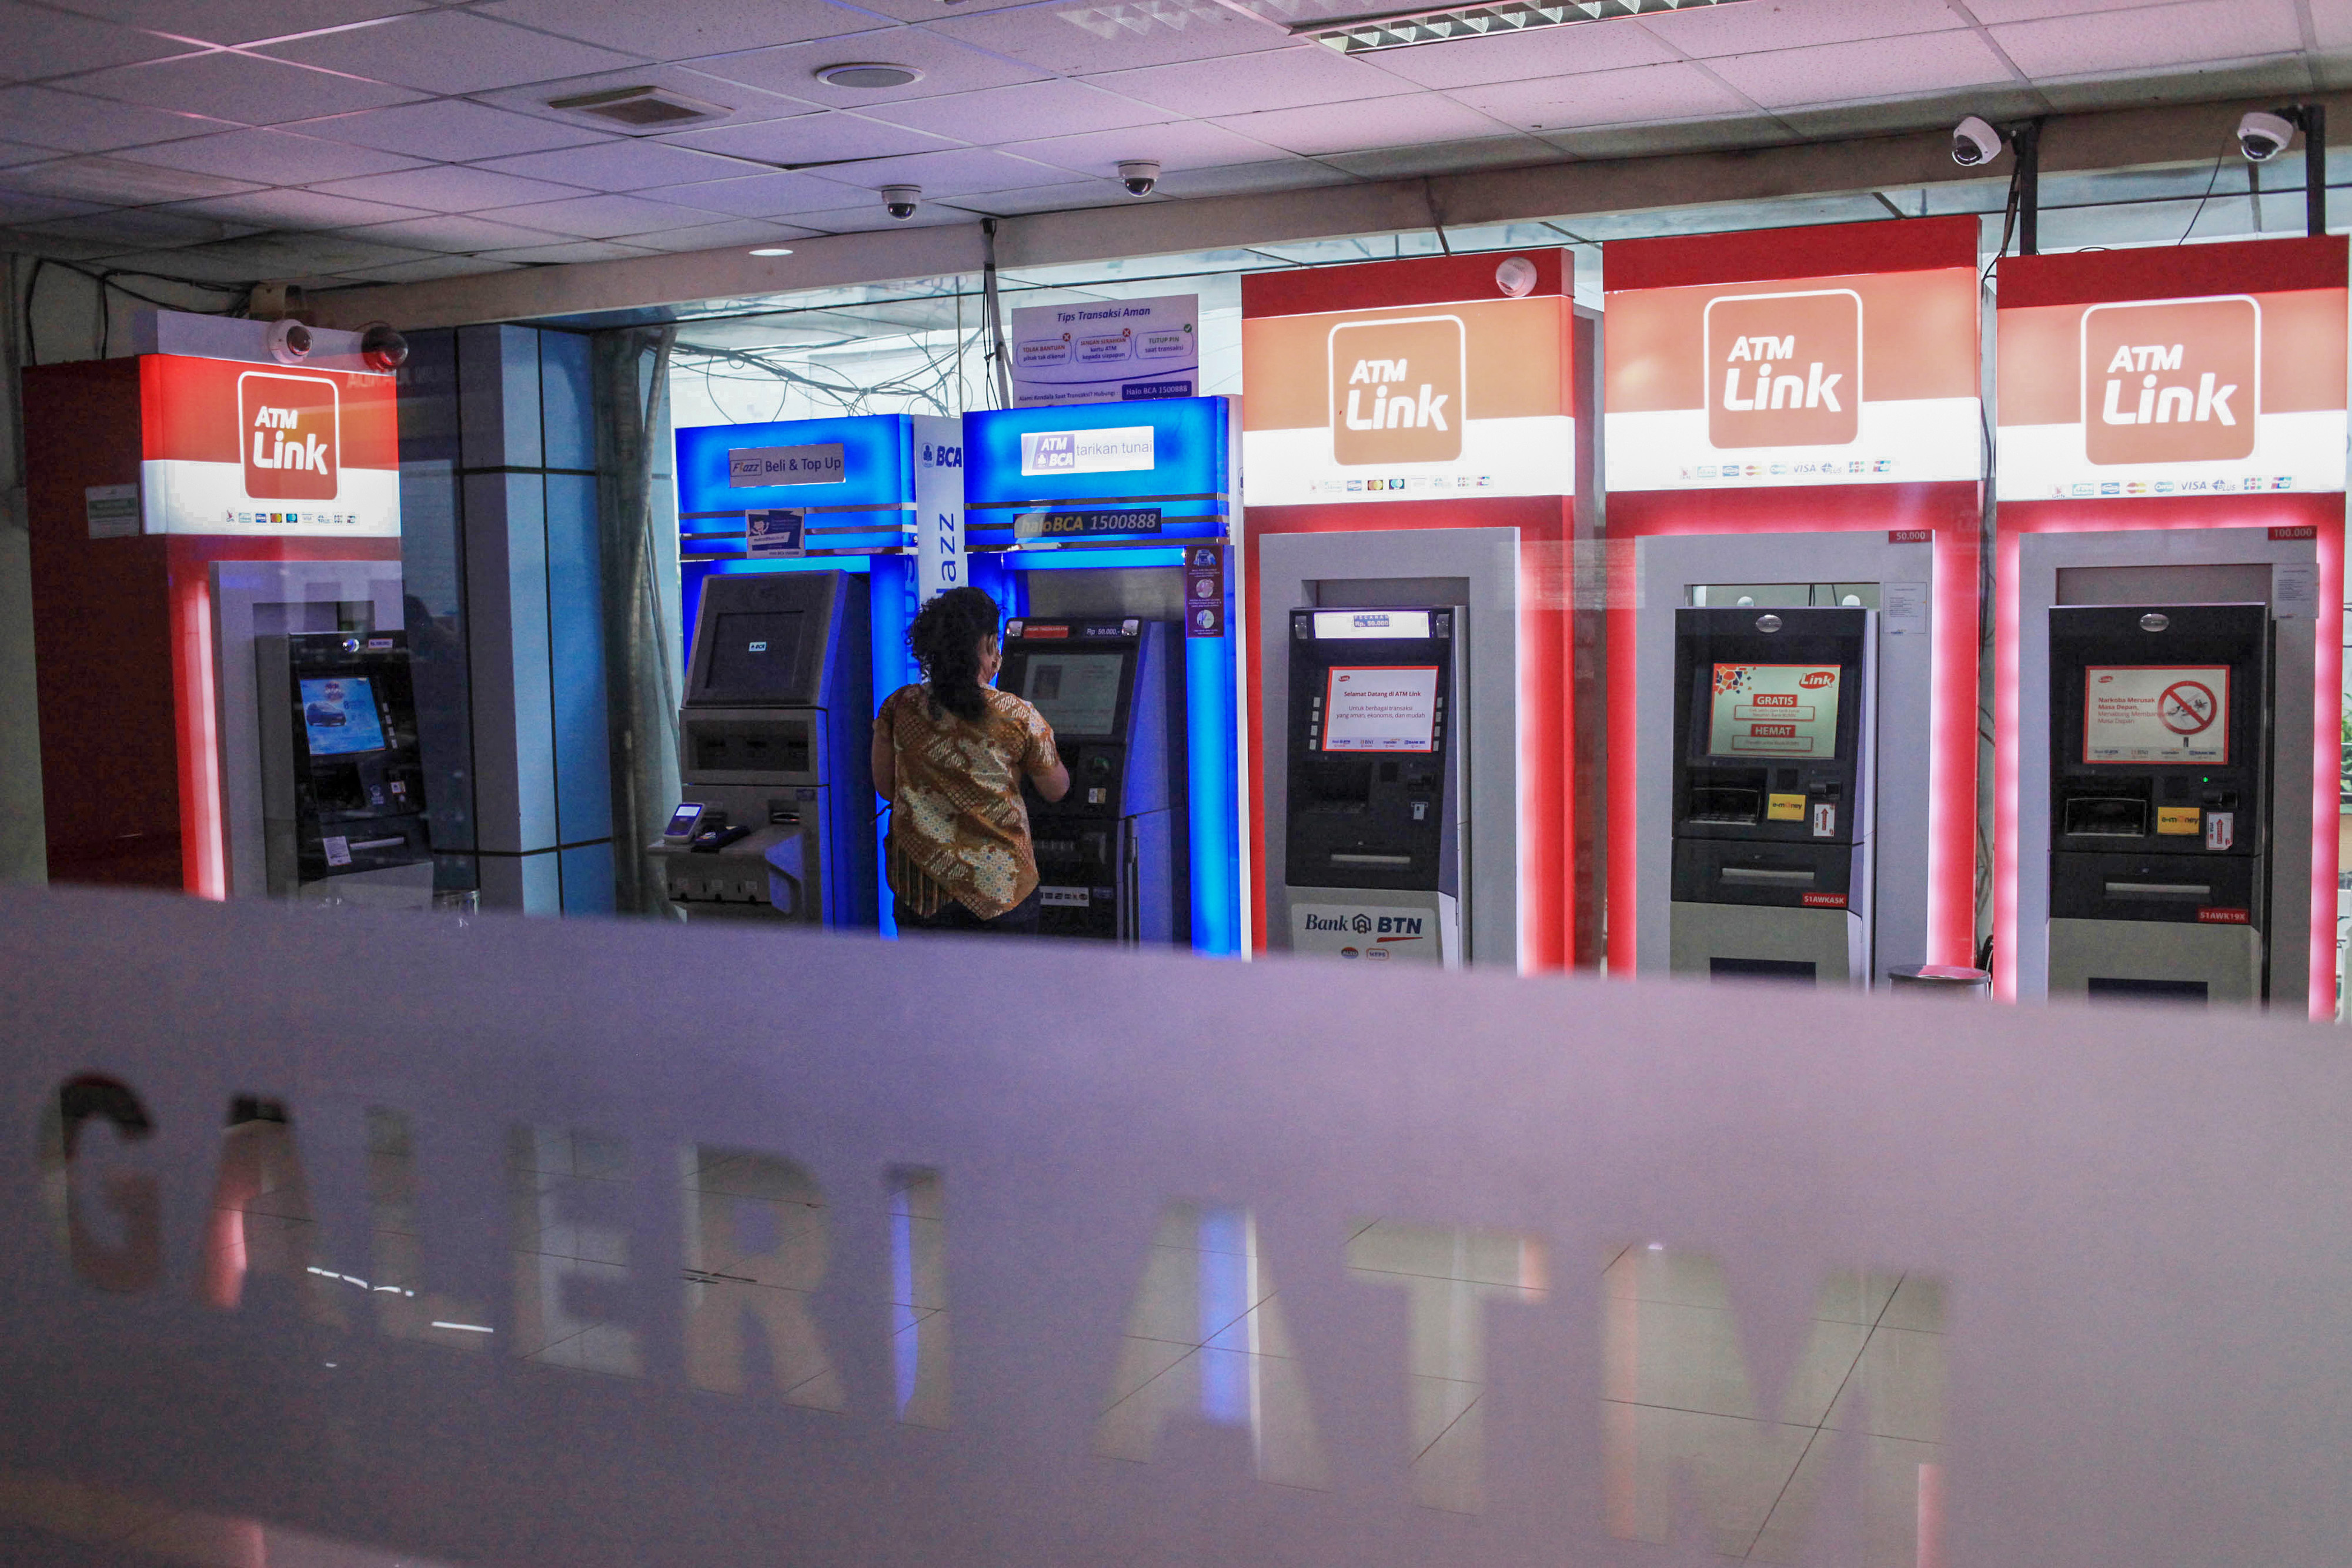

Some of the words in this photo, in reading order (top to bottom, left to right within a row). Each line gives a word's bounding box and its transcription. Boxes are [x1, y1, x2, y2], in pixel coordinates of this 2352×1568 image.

[1057, 312, 1075, 323] Tips
[1078, 309, 1121, 320] Transaksi
[1123, 306, 1151, 317] Aman
[1728, 335, 1795, 362] ATM
[2107, 344, 2183, 373] ATM
[1349, 358, 1407, 385] ATM
[1158, 385, 1188, 393] 1500888
[1723, 362, 1843, 412] Link
[1347, 384, 1448, 431] Link
[2103, 372, 2237, 426] Link
[255, 406, 298, 429] ATM
[253, 430, 328, 475] Link
[1041, 437, 1068, 451] ATM
[1076, 442, 1118, 456] tarikan
[1122, 439, 1152, 454] tunai
[733, 462, 760, 474] Flazz
[766, 460, 786, 473] Beli
[789, 459, 799, 471] &
[801, 459, 821, 473] Top
[825, 456, 841, 471] Up
[936, 446, 963, 468] BCA
[1048, 452, 1073, 467] BCA
[1793, 463, 1817, 473] VISA
[2181, 480, 2207, 490] VISA
[1090, 514, 1157, 530] 1500888
[1896, 531, 1926, 540] 50.000
[2274, 528, 2313, 537] 100.000
[1801, 673, 1833, 688] Link
[1757, 696, 1794, 706] GRATIS
[1755, 727, 1792, 735] HEMAT
[1305, 914, 1348, 931] Bank
[1377, 917, 1422, 934] BTN
[35, 1072, 954, 1431] GALERI
